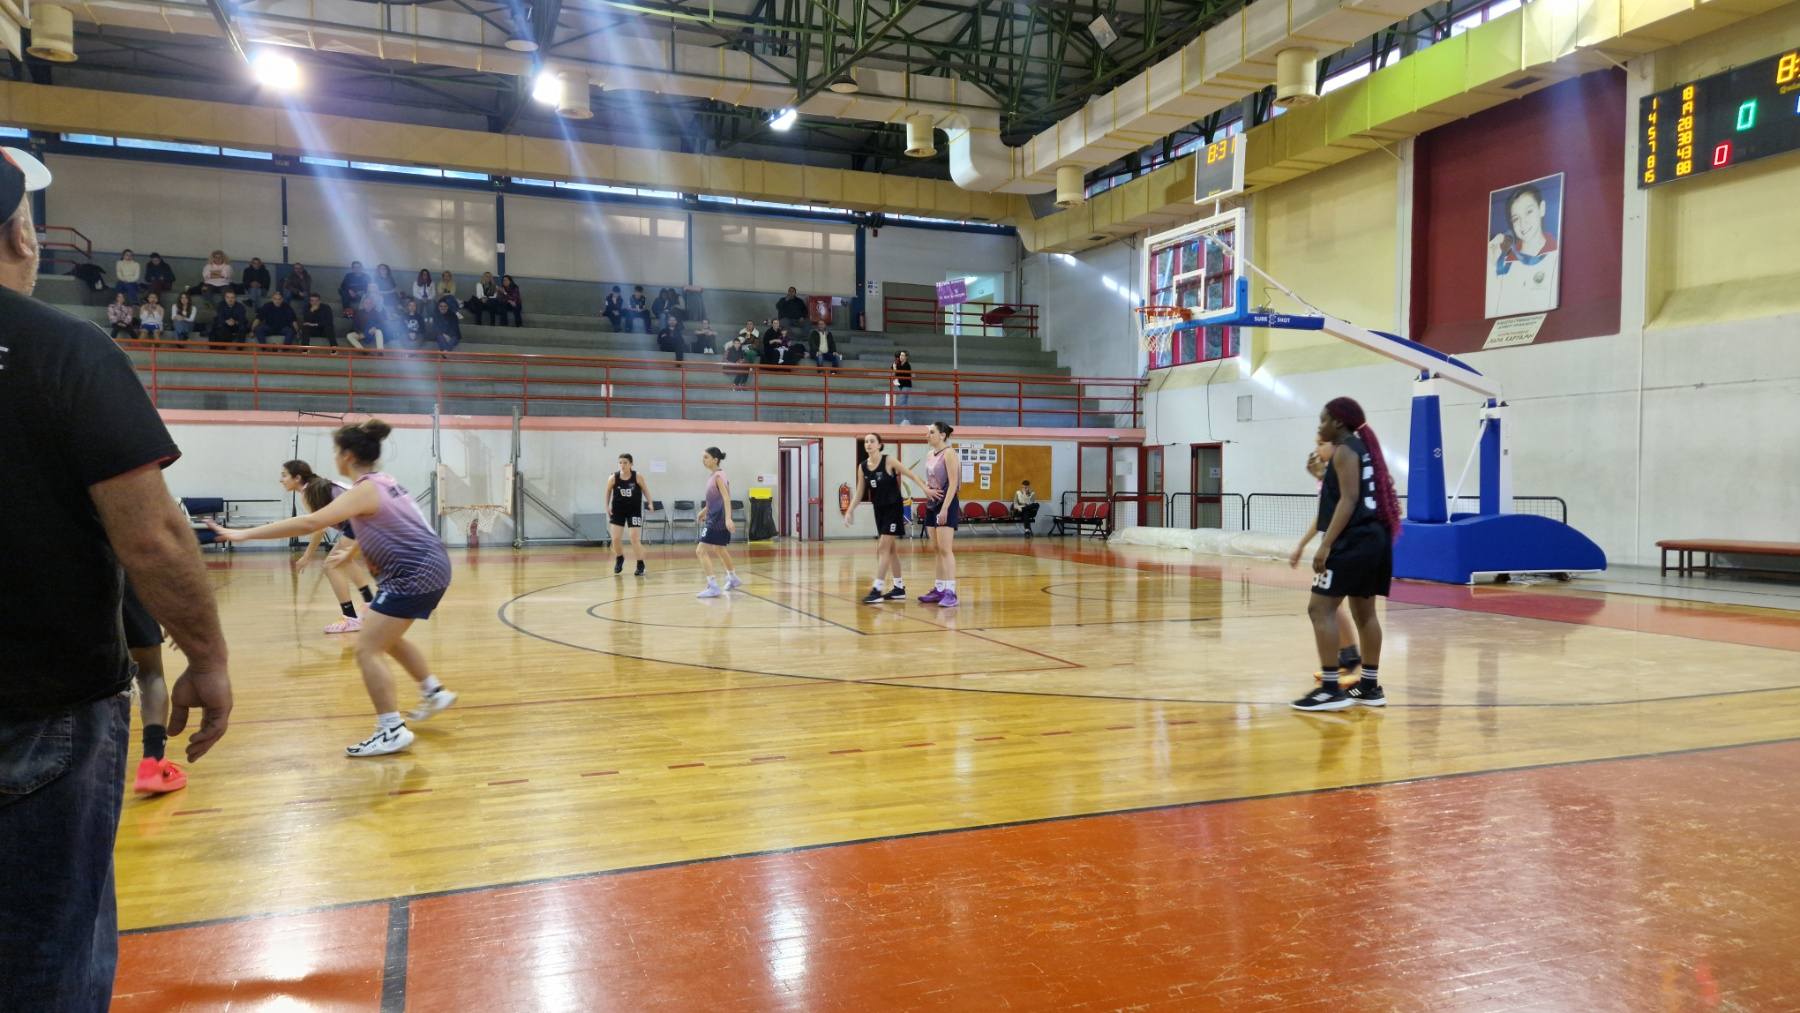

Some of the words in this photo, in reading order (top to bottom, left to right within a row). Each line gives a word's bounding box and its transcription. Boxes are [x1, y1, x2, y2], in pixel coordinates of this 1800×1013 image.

[1653, 98, 1658, 110] 1
[1648, 111, 1657, 124] 4
[1736, 101, 1756, 132] 0
[1647, 126, 1656, 140] 5
[1207, 136, 1236, 165] 8:31
[1648, 140, 1656, 153] 7
[1713, 144, 1729, 166] 0
